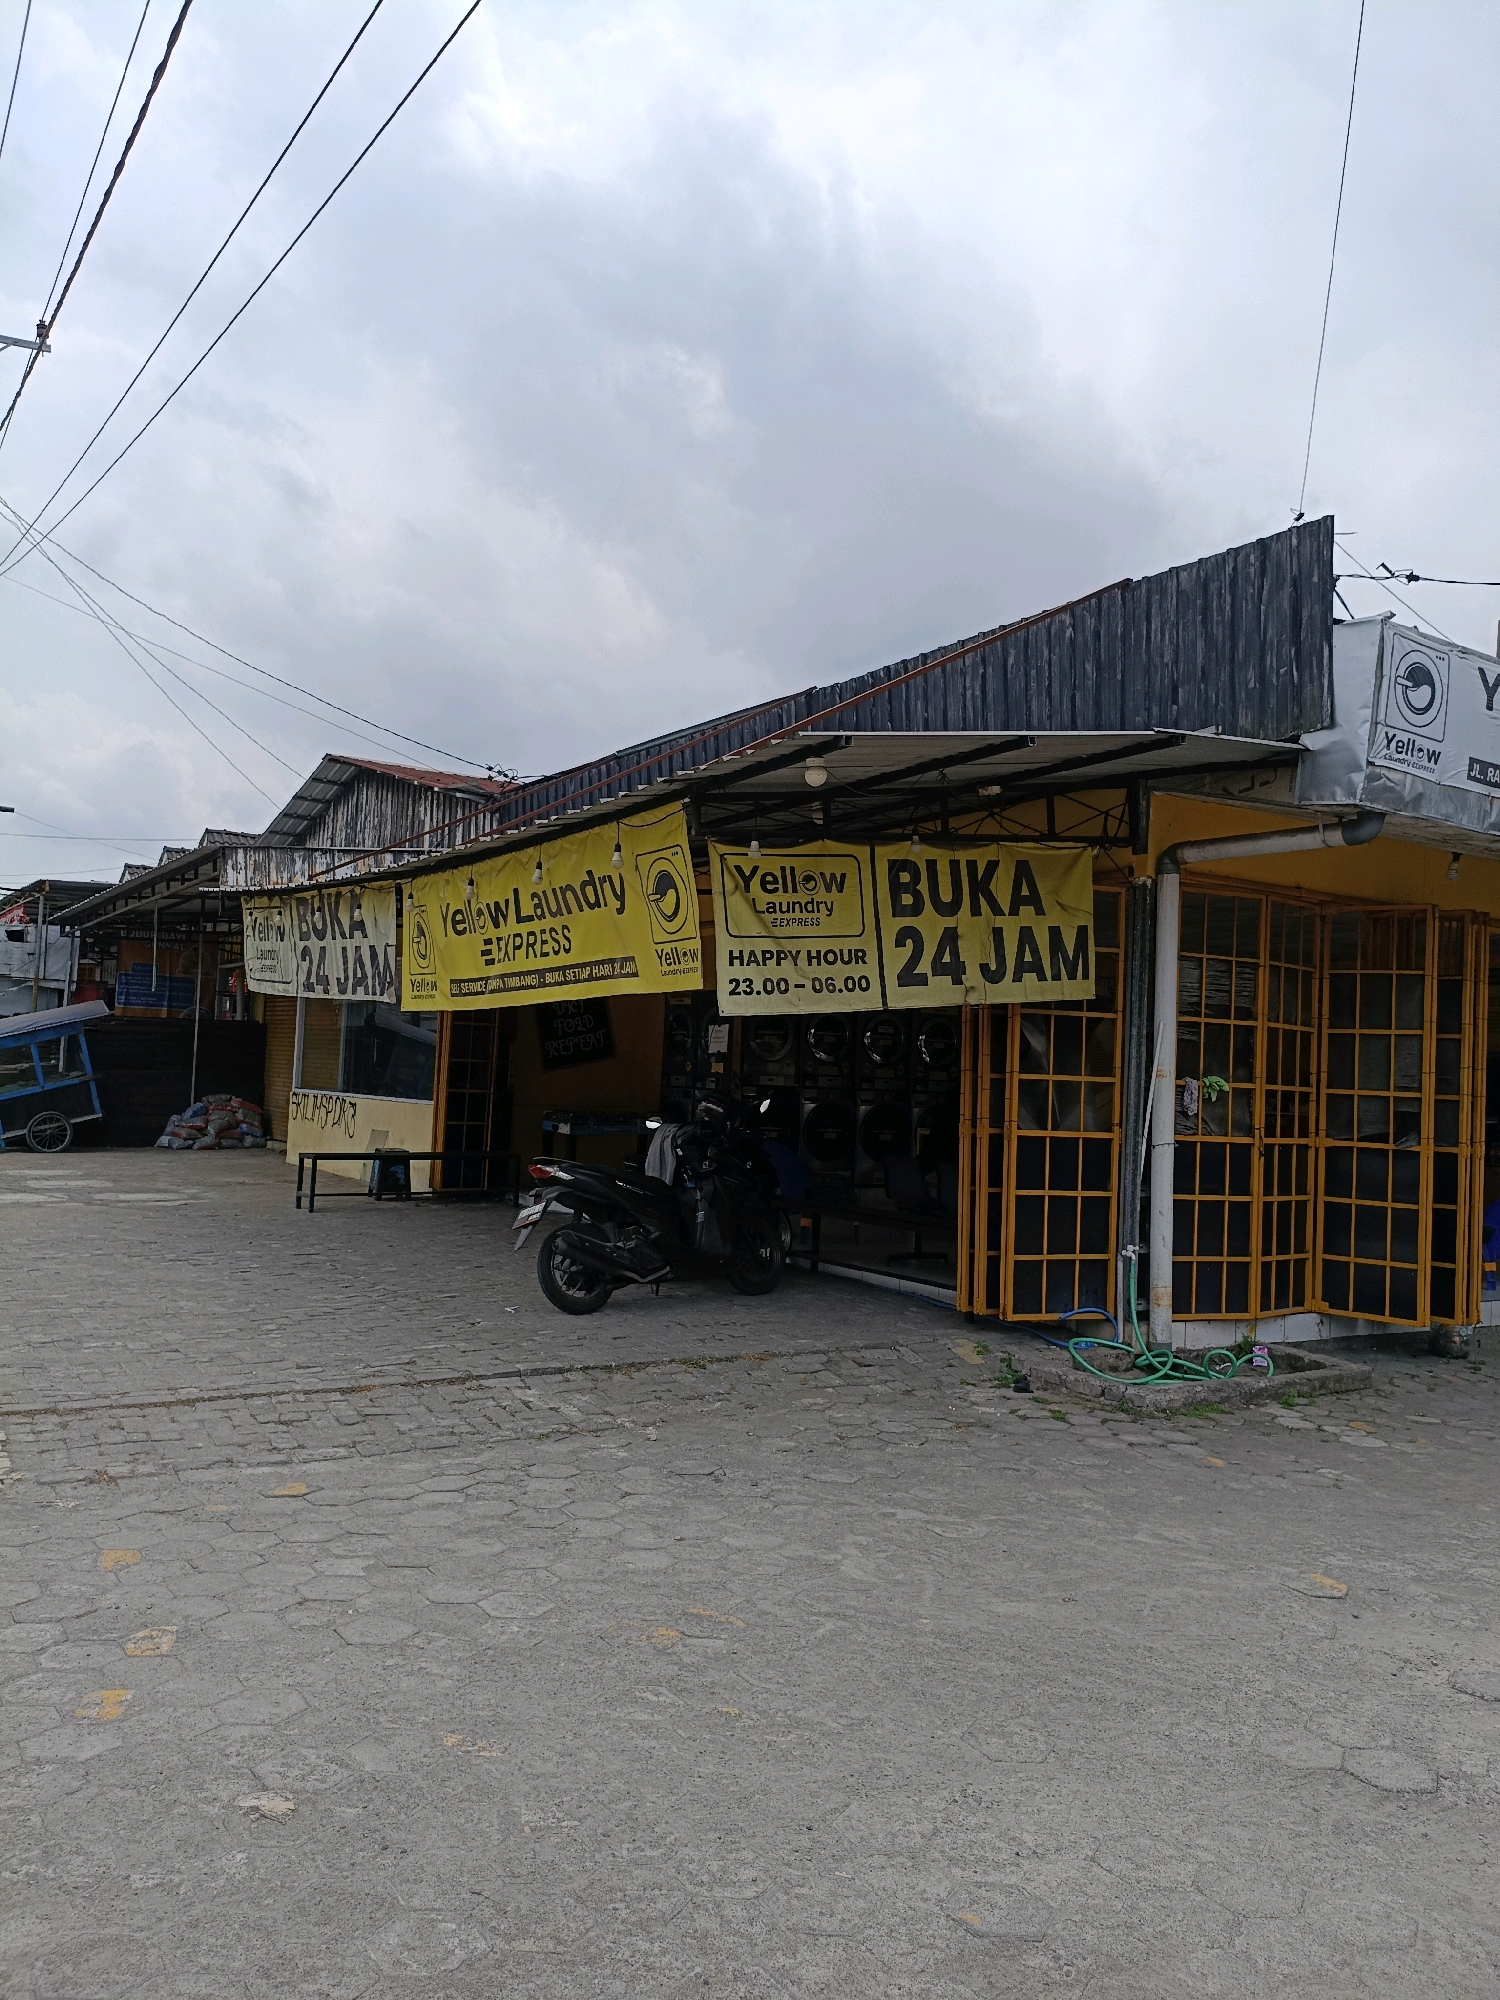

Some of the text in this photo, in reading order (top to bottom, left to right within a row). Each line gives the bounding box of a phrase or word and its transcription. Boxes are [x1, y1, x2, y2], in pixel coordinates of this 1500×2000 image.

[1384, 731, 1441, 766] Yellow
[1384, 753, 1411, 768] Laundry
[1470, 762, 1484, 779] JL.
[733, 864, 847, 896] Yellow
[886, 858, 1046, 918] BUKA
[295, 889, 368, 942] BUKA
[752, 897, 834, 917] Laundry
[776, 917, 821, 928] EXPRESS
[495, 924, 572, 965] EXPRESS
[654, 946, 699, 967] Yellow
[728, 948, 868, 967] HAPPY HOUR
[893, 923, 1090, 988] 24 JAM
[301, 944, 394, 997] 24 JAM
[450, 983, 460, 994] SEL
[461, 980, 486, 994] SERVICE
[504, 973, 539, 988] TIMBANG)
[545, 971, 565, 984] BUKA
[565, 966, 591, 981] SETIAP
[592, 963, 613, 977] HARI
[620, 961, 637, 974] JAM
[410, 977, 438, 993] Yellow
[728, 976, 790, 997] 23.00
[811, 974, 871, 994] 06.00
[553, 1014, 594, 1037] FOLD
[545, 1028, 607, 1058] REPEAT
